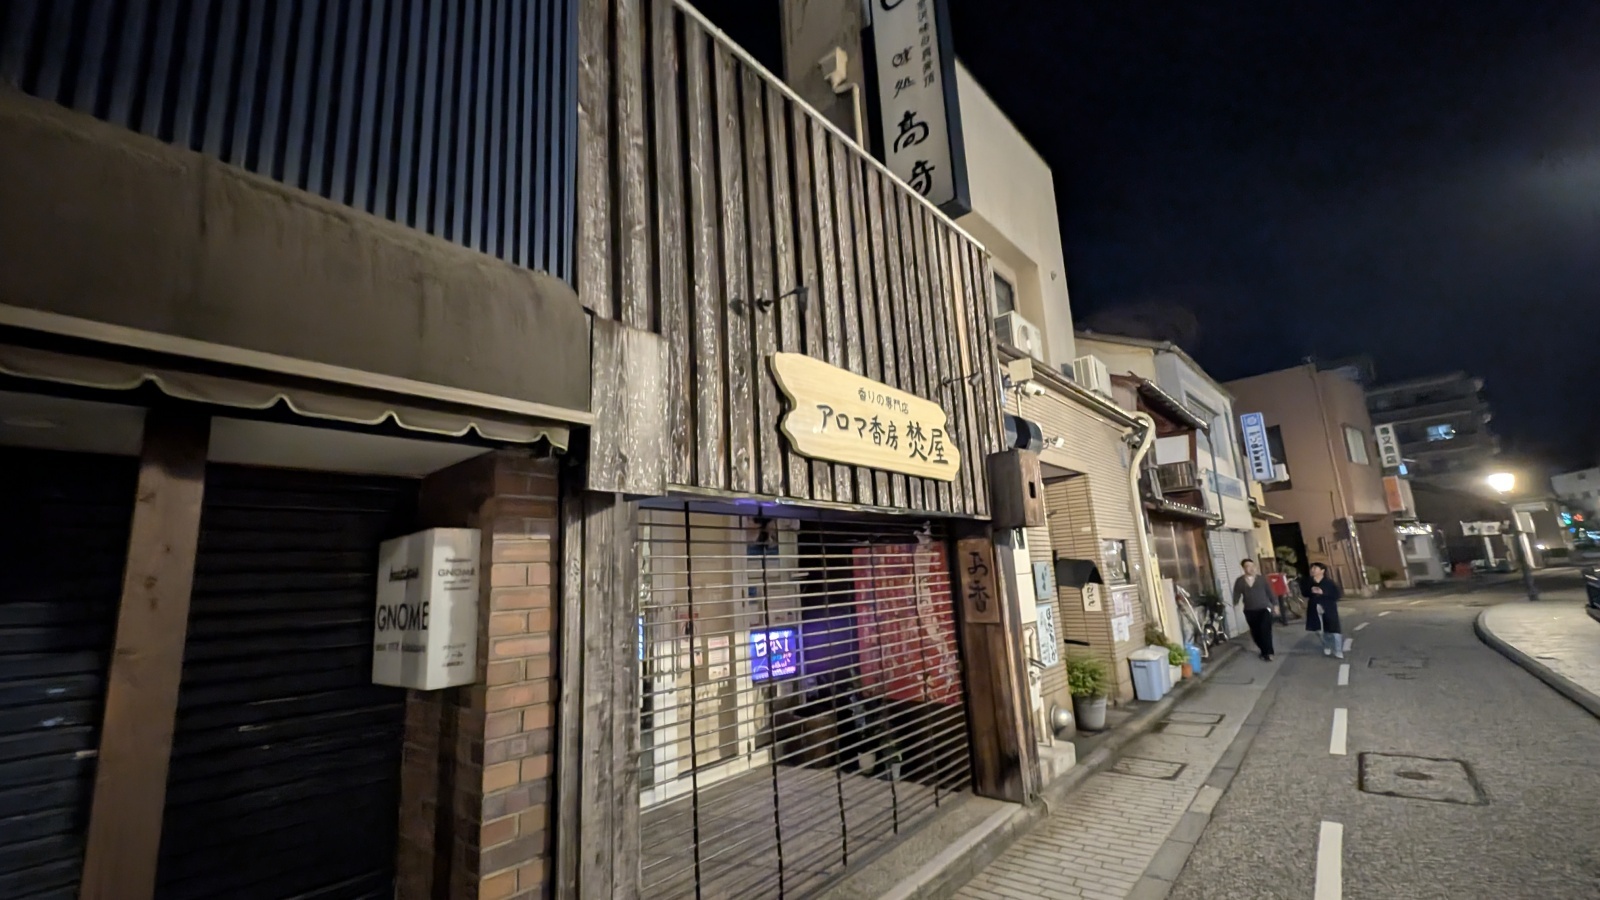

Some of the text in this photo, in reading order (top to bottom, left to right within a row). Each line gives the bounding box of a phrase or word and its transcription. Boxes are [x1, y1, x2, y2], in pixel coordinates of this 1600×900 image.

[816, 404, 949, 465] アロマ香房 焚屋
[967, 551, 990, 613] お香
[377, 601, 430, 632] GNOME
